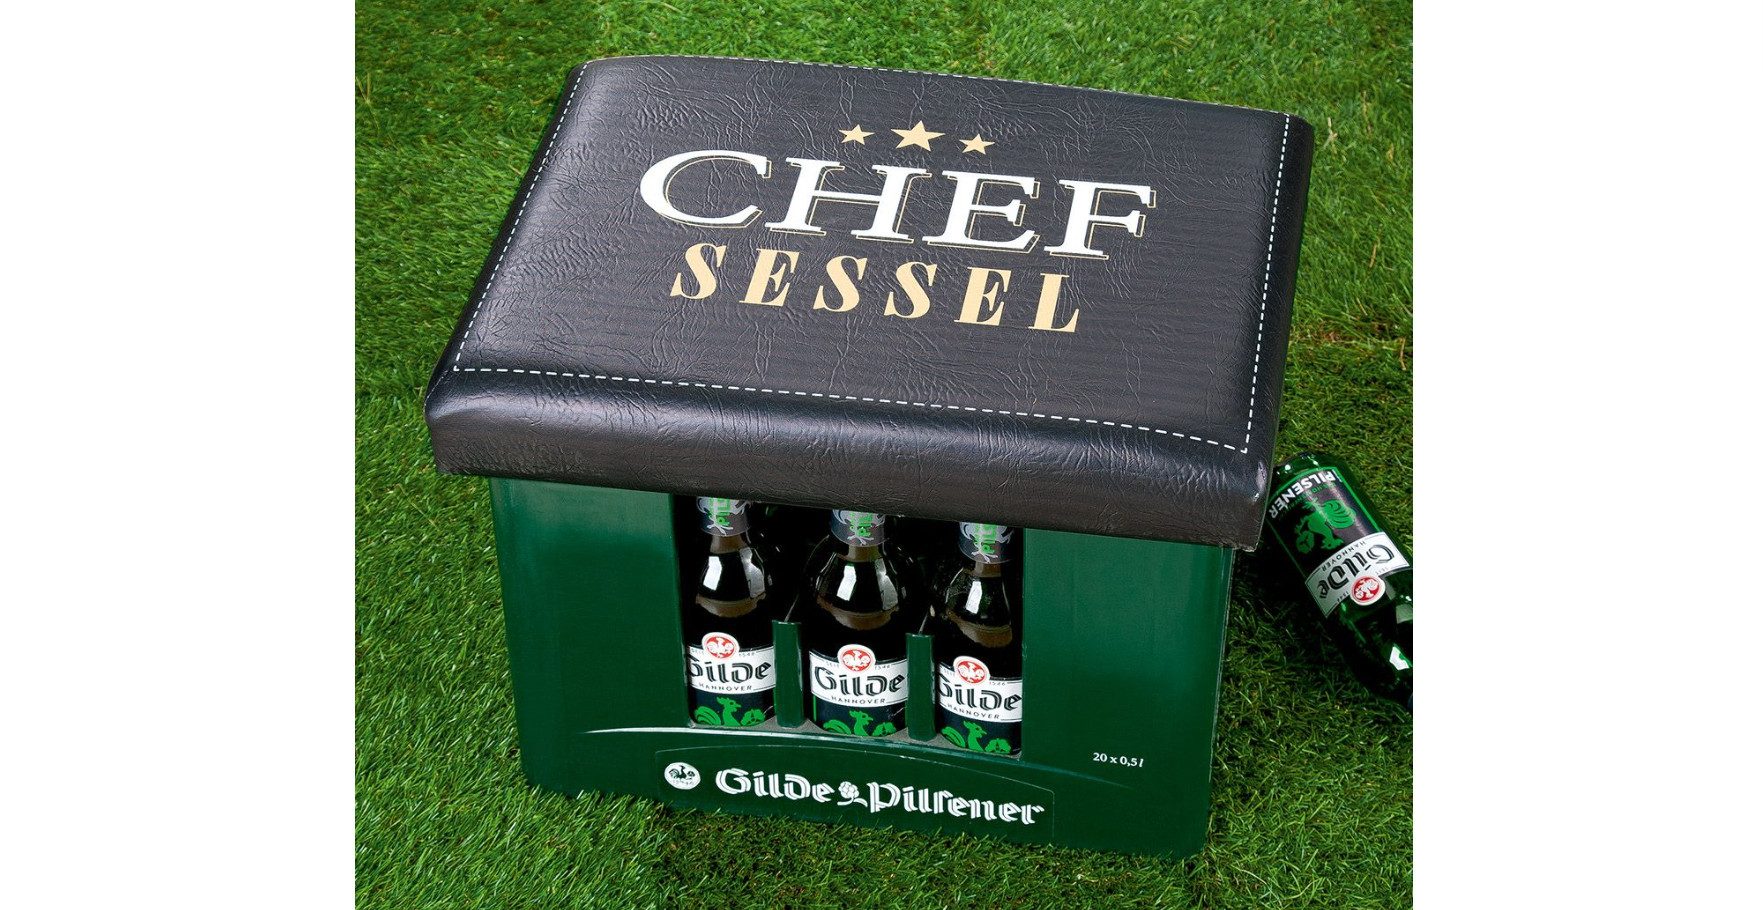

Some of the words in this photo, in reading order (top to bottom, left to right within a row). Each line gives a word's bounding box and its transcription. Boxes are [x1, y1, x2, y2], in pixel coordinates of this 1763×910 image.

[640, 149, 1156, 260] CHEF
[670, 243, 1080, 333] SESSEL
[1268, 470, 1336, 519] PILSENER
[1316, 544, 1395, 599] Gilde
[1322, 540, 1367, 572] HANNOVER
[699, 683, 752, 691] HANNOVER
[814, 666, 905, 696] Gilde
[831, 696, 886, 704] HANNOVER
[947, 704, 1000, 719] HANNOVER
[1093, 752, 1108, 763] 20
[715, 767, 835, 803] Gilde
